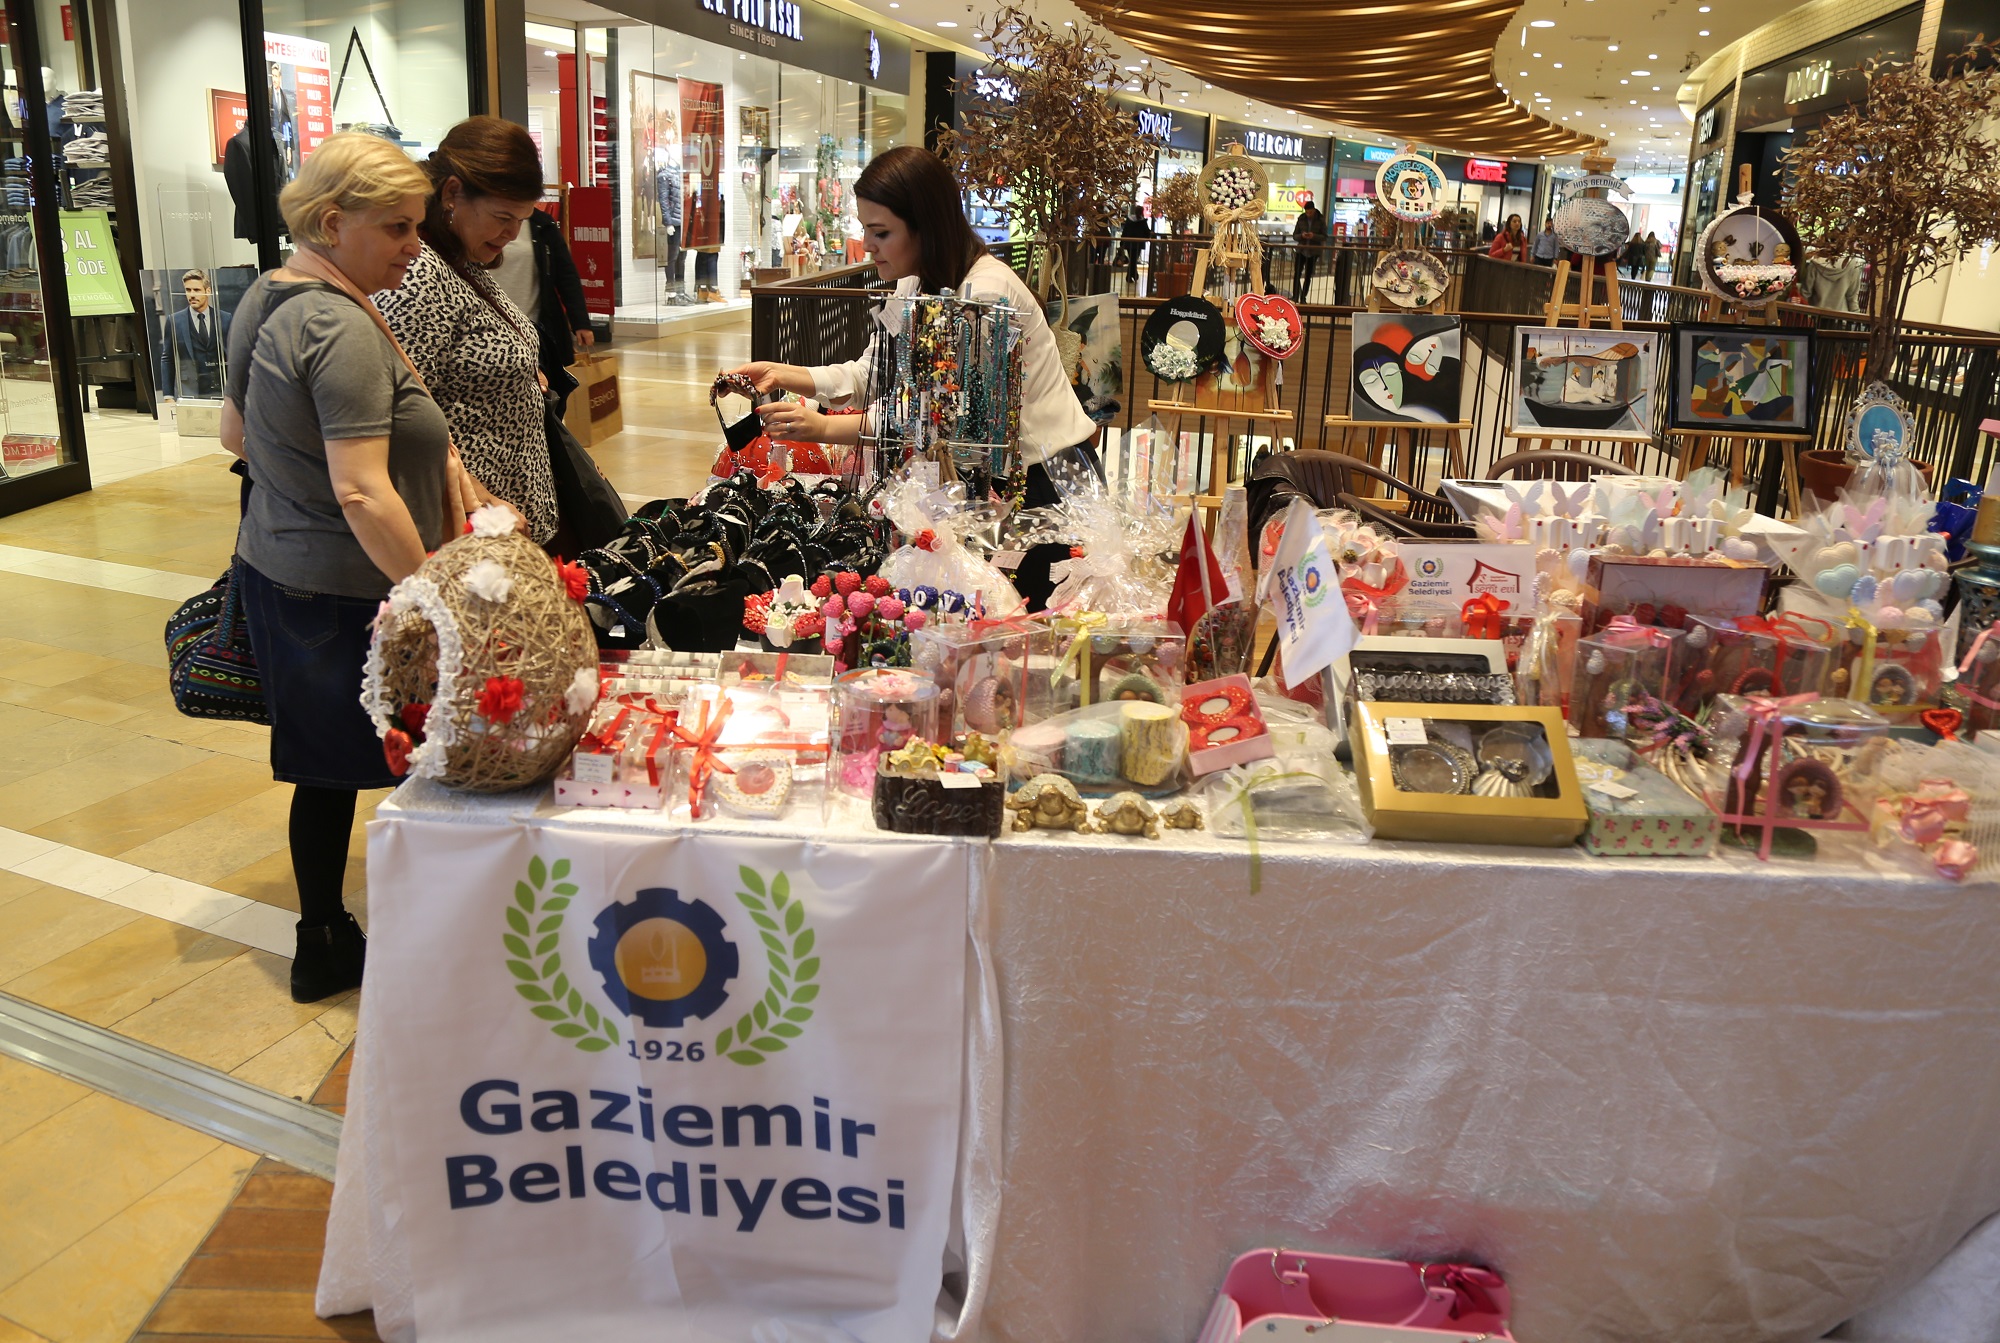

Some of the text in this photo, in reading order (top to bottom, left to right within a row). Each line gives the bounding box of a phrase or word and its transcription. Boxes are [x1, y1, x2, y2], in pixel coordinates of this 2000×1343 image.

[733, 0, 765, 28] POLO
[769, 0, 804, 41] ASSN.
[729, 23, 776, 48] SINCE 1890
[1246, 132, 1303, 157] TERGAN
[1277, 190, 1295, 203] 70
[74, 230, 97, 249] AL
[77, 257, 107, 275] ÖDE
[1411, 579, 1450, 588] Gaziemir
[627, 1039, 706, 1063] 1926
[459, 1078, 876, 1159] Gaziemir
[445, 1145, 906, 1233] Belediyesi
